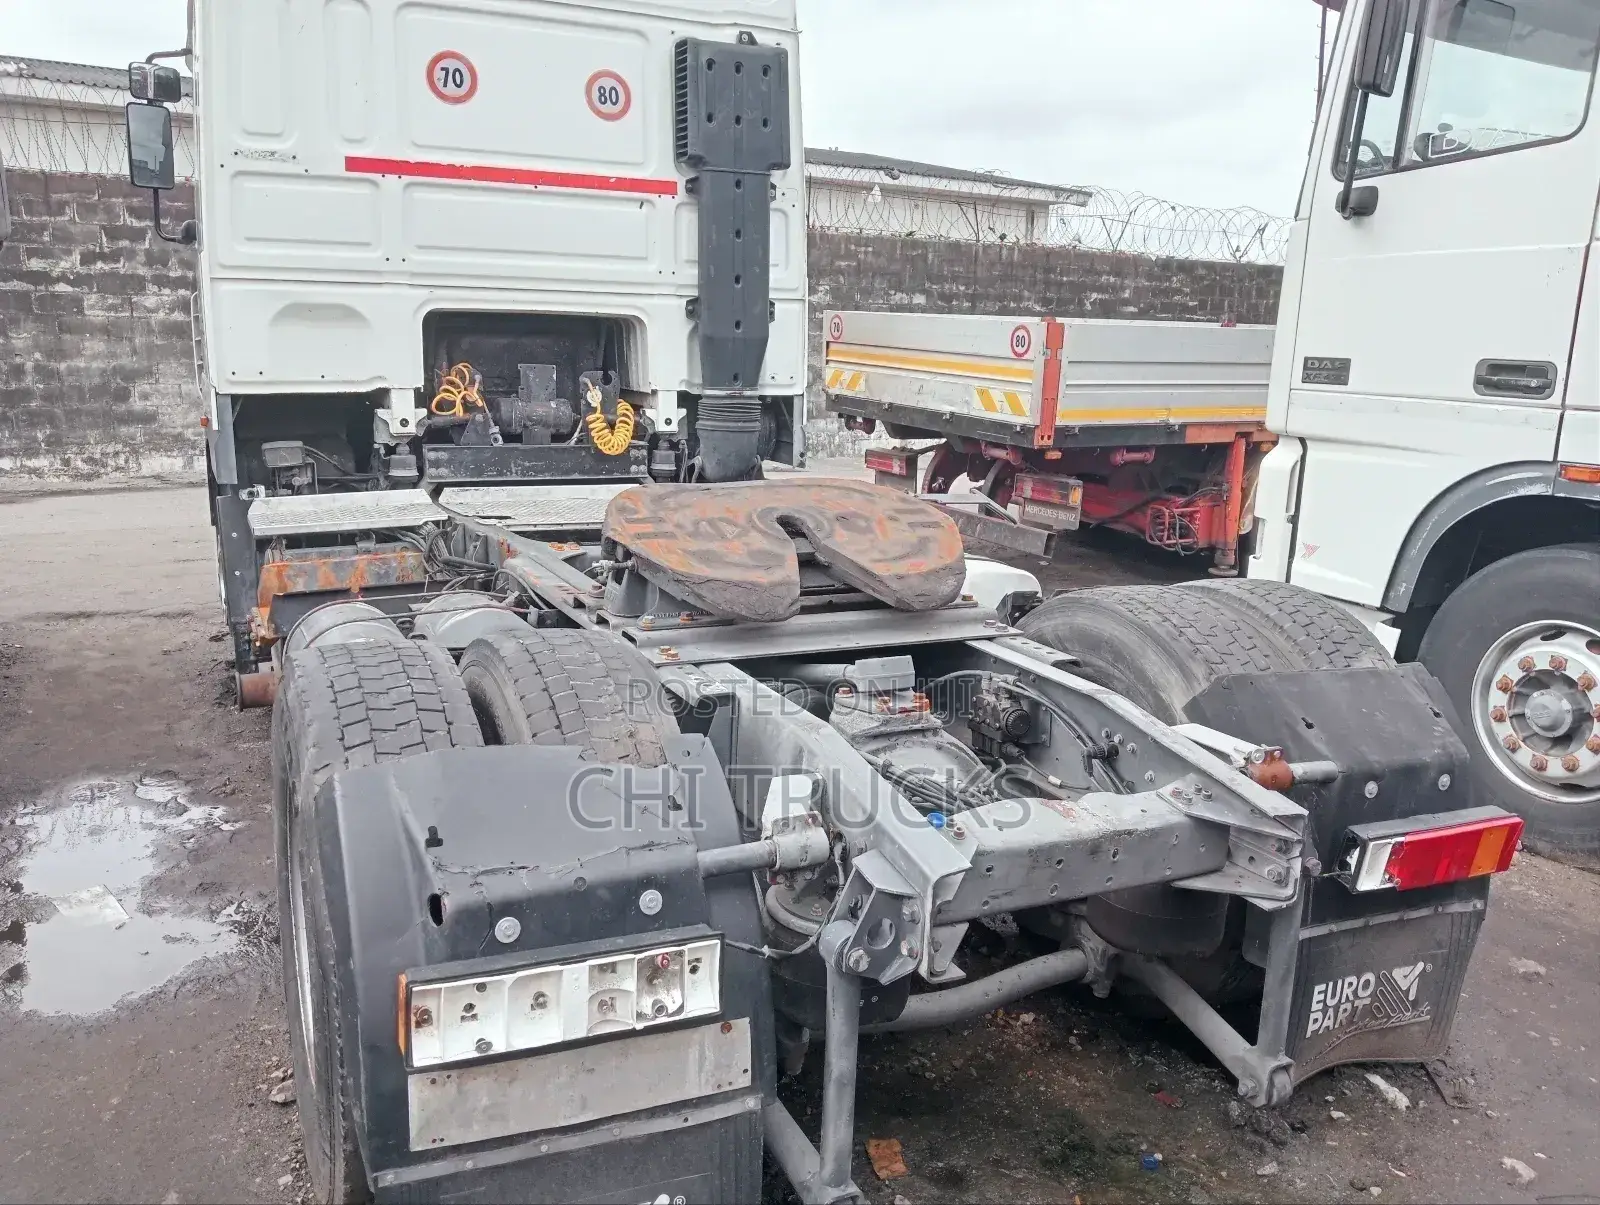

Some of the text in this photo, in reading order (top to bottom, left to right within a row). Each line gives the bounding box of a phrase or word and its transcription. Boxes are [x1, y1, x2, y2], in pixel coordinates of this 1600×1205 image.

[440, 66, 465, 89] 70
[597, 85, 620, 107] 80
[833, 321, 840, 333] 70
[1015, 334, 1026, 348] 80
[1307, 359, 1347, 369] DAF
[1025, 504, 1076, 521] MERCEDES-BENZ
[1310, 971, 1376, 1012] EURO
[1305, 997, 1372, 1039] PART
